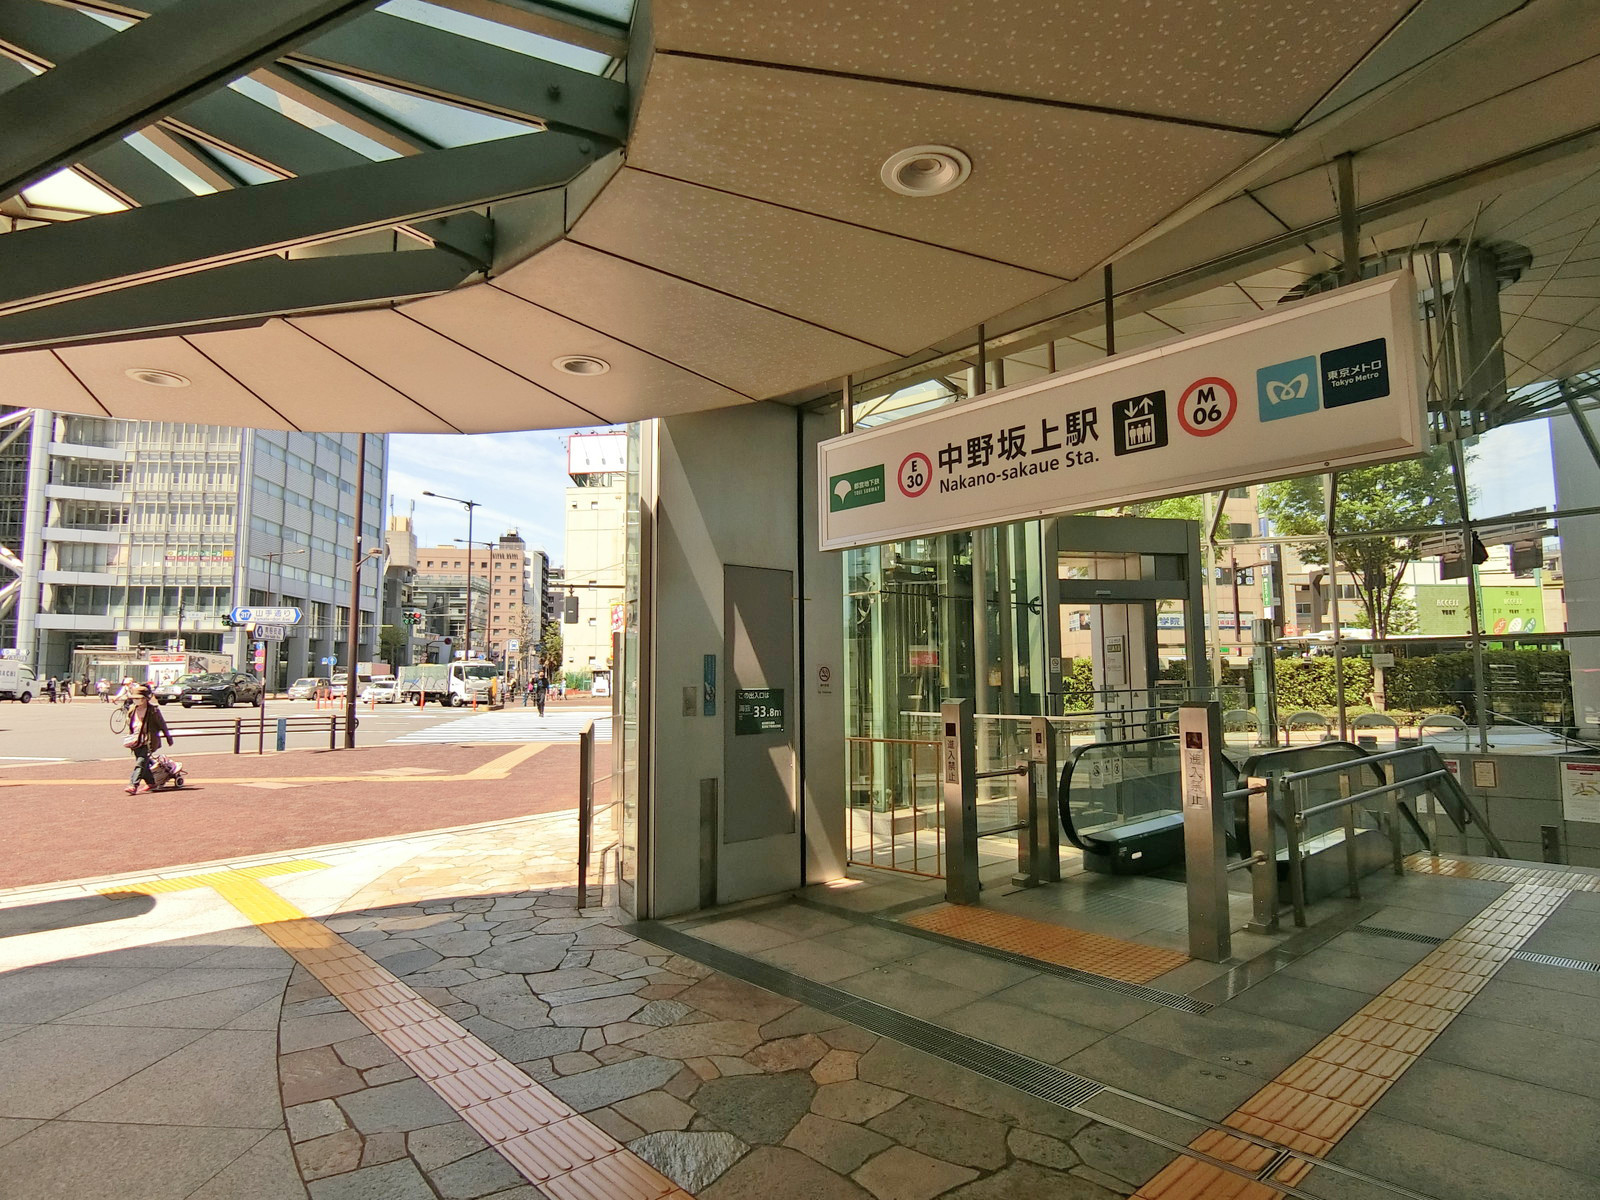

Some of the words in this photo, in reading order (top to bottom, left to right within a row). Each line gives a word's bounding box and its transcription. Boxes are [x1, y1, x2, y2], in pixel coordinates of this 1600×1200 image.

[1327, 360, 1382, 381] 東京メトロ
[1331, 377, 1354, 387] Tokyo
[1355, 372, 1379, 382] Metro
[1197, 386, 1216, 405] M
[1193, 404, 1222, 425] 06
[937, 407, 1099, 474] 中野坂上駅
[911, 460, 918, 473] E
[939, 458, 1060, 494] Nakano-sakaue
[1066, 449, 1100, 468] Sta.
[907, 473, 924, 489] 30
[738, 691, 770, 700] この出入口は
[753, 705, 782, 718] 33.8m
[947, 739, 956, 782] 進入禁止
[1189, 752, 1203, 805] 進入禁止
